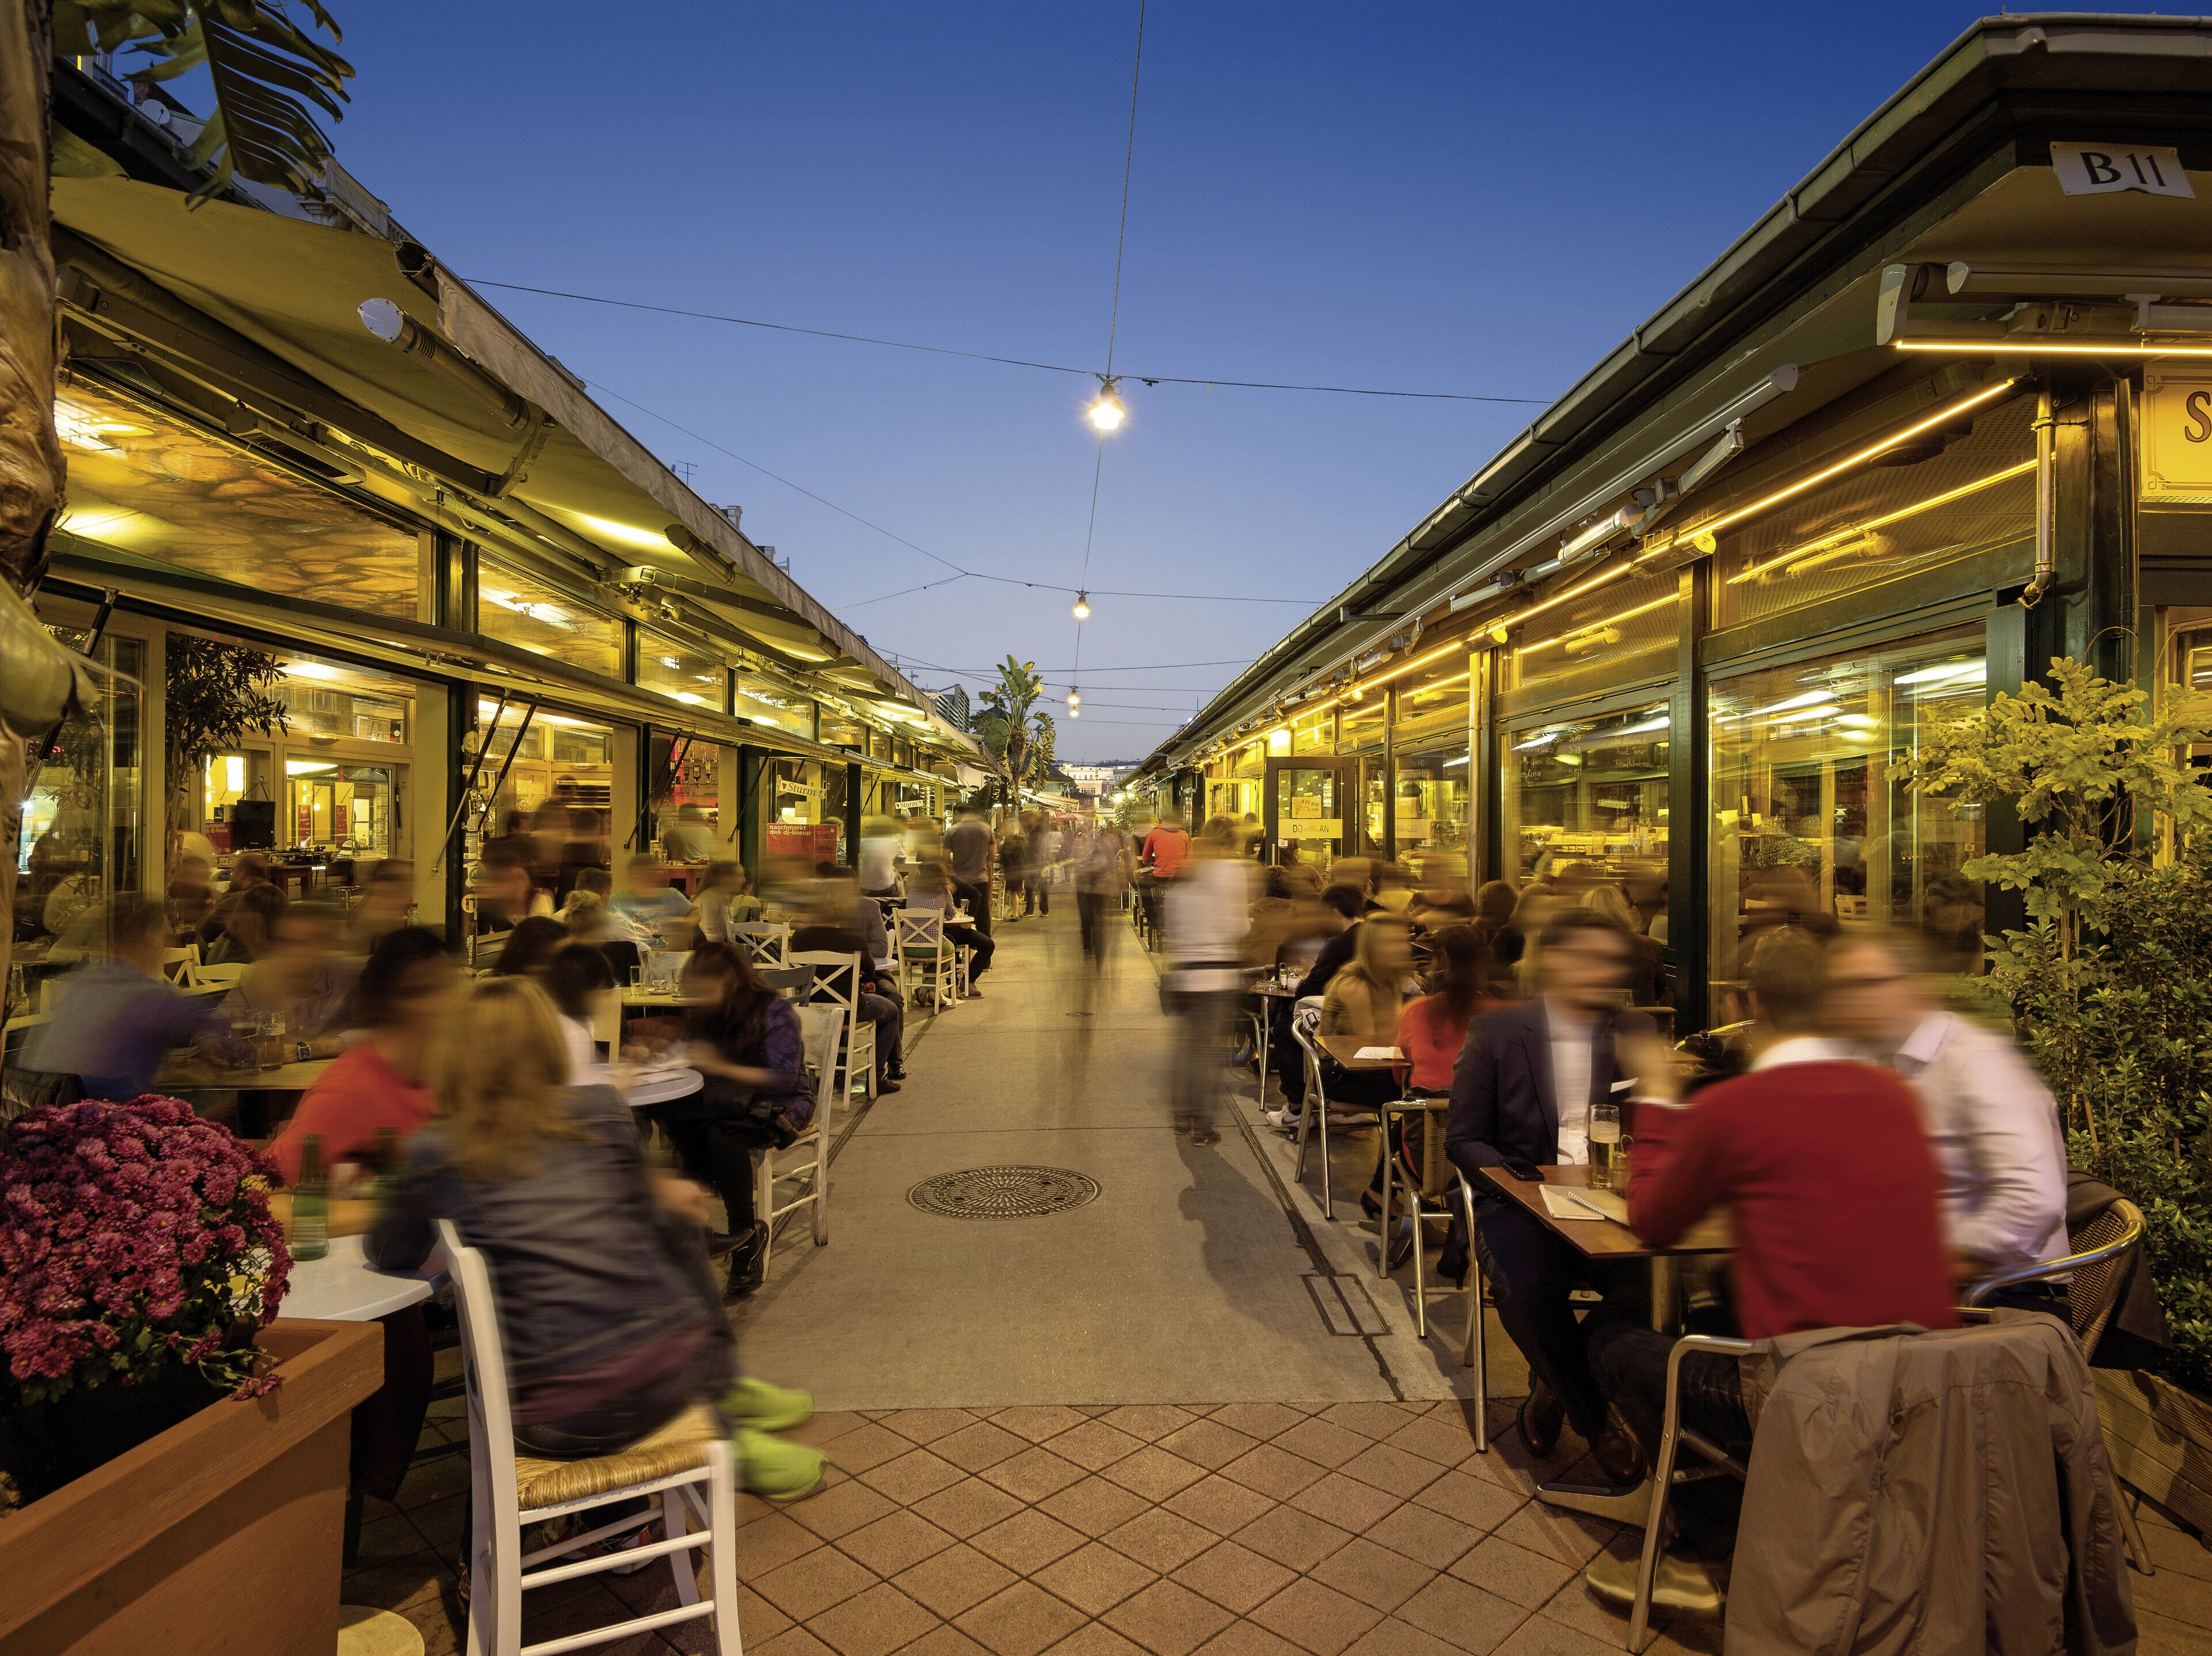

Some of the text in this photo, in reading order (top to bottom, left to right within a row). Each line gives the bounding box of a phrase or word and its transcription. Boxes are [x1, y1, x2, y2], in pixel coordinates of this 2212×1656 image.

[1566, 768, 1582, 778] 3,80
[787, 782, 816, 796] Sturm
[1301, 799, 1320, 807] STURM
